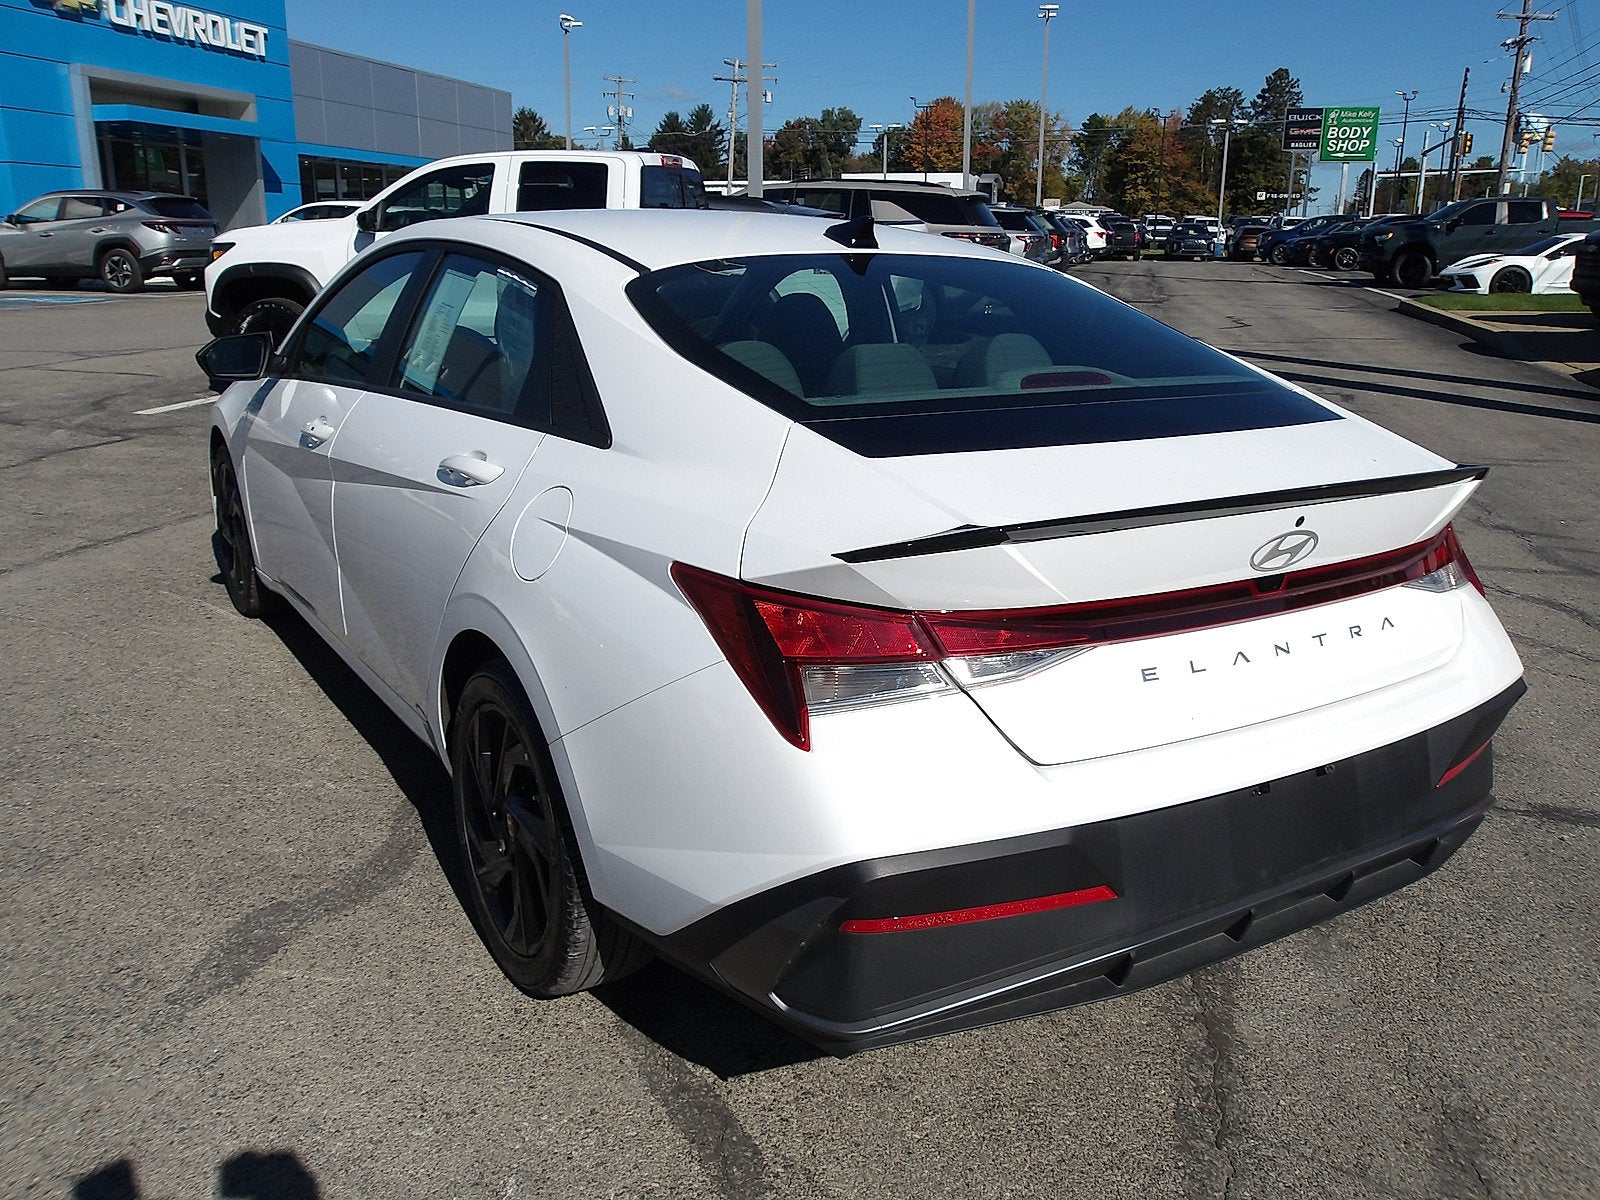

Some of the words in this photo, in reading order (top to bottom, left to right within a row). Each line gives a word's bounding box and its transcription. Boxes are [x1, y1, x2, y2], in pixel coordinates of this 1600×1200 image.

[107, 0, 268, 57] CHEVROLET
[1340, 110, 1357, 118] Mike
[1358, 110, 1376, 119] Kelly
[1327, 126, 1373, 139] BODY
[1326, 139, 1370, 152] SHOP
[1140, 616, 1395, 683] ELANTRA
